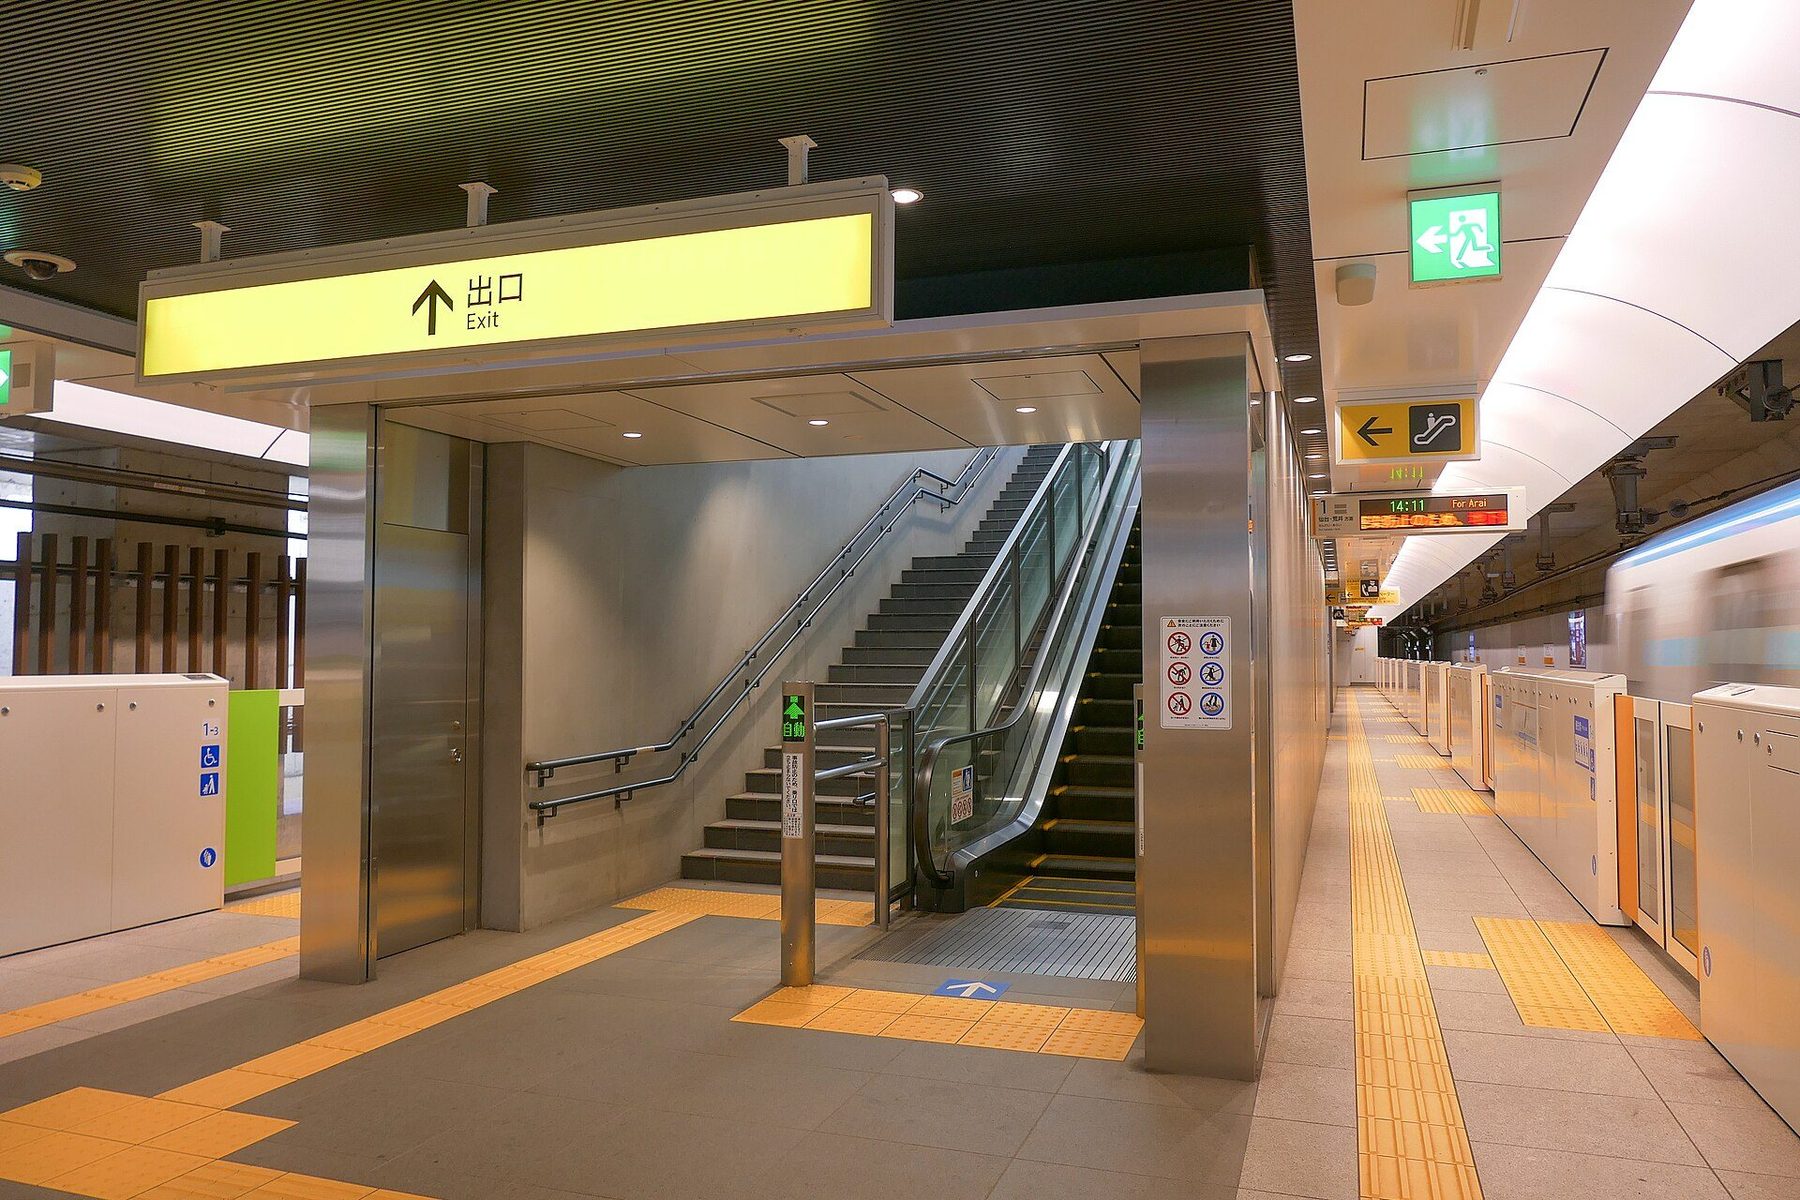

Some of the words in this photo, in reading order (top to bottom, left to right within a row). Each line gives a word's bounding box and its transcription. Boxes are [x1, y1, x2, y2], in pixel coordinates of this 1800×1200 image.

[467, 273, 522, 308] 出口
[467, 311, 499, 330] Exit
[1320, 500, 1326, 514] 1
[1390, 499, 1424, 512] 14:11
[1452, 499, 1466, 508] For
[1468, 498, 1487, 507] Arai
[203, 722, 219, 736] 1-3
[783, 721, 805, 738] 自動
